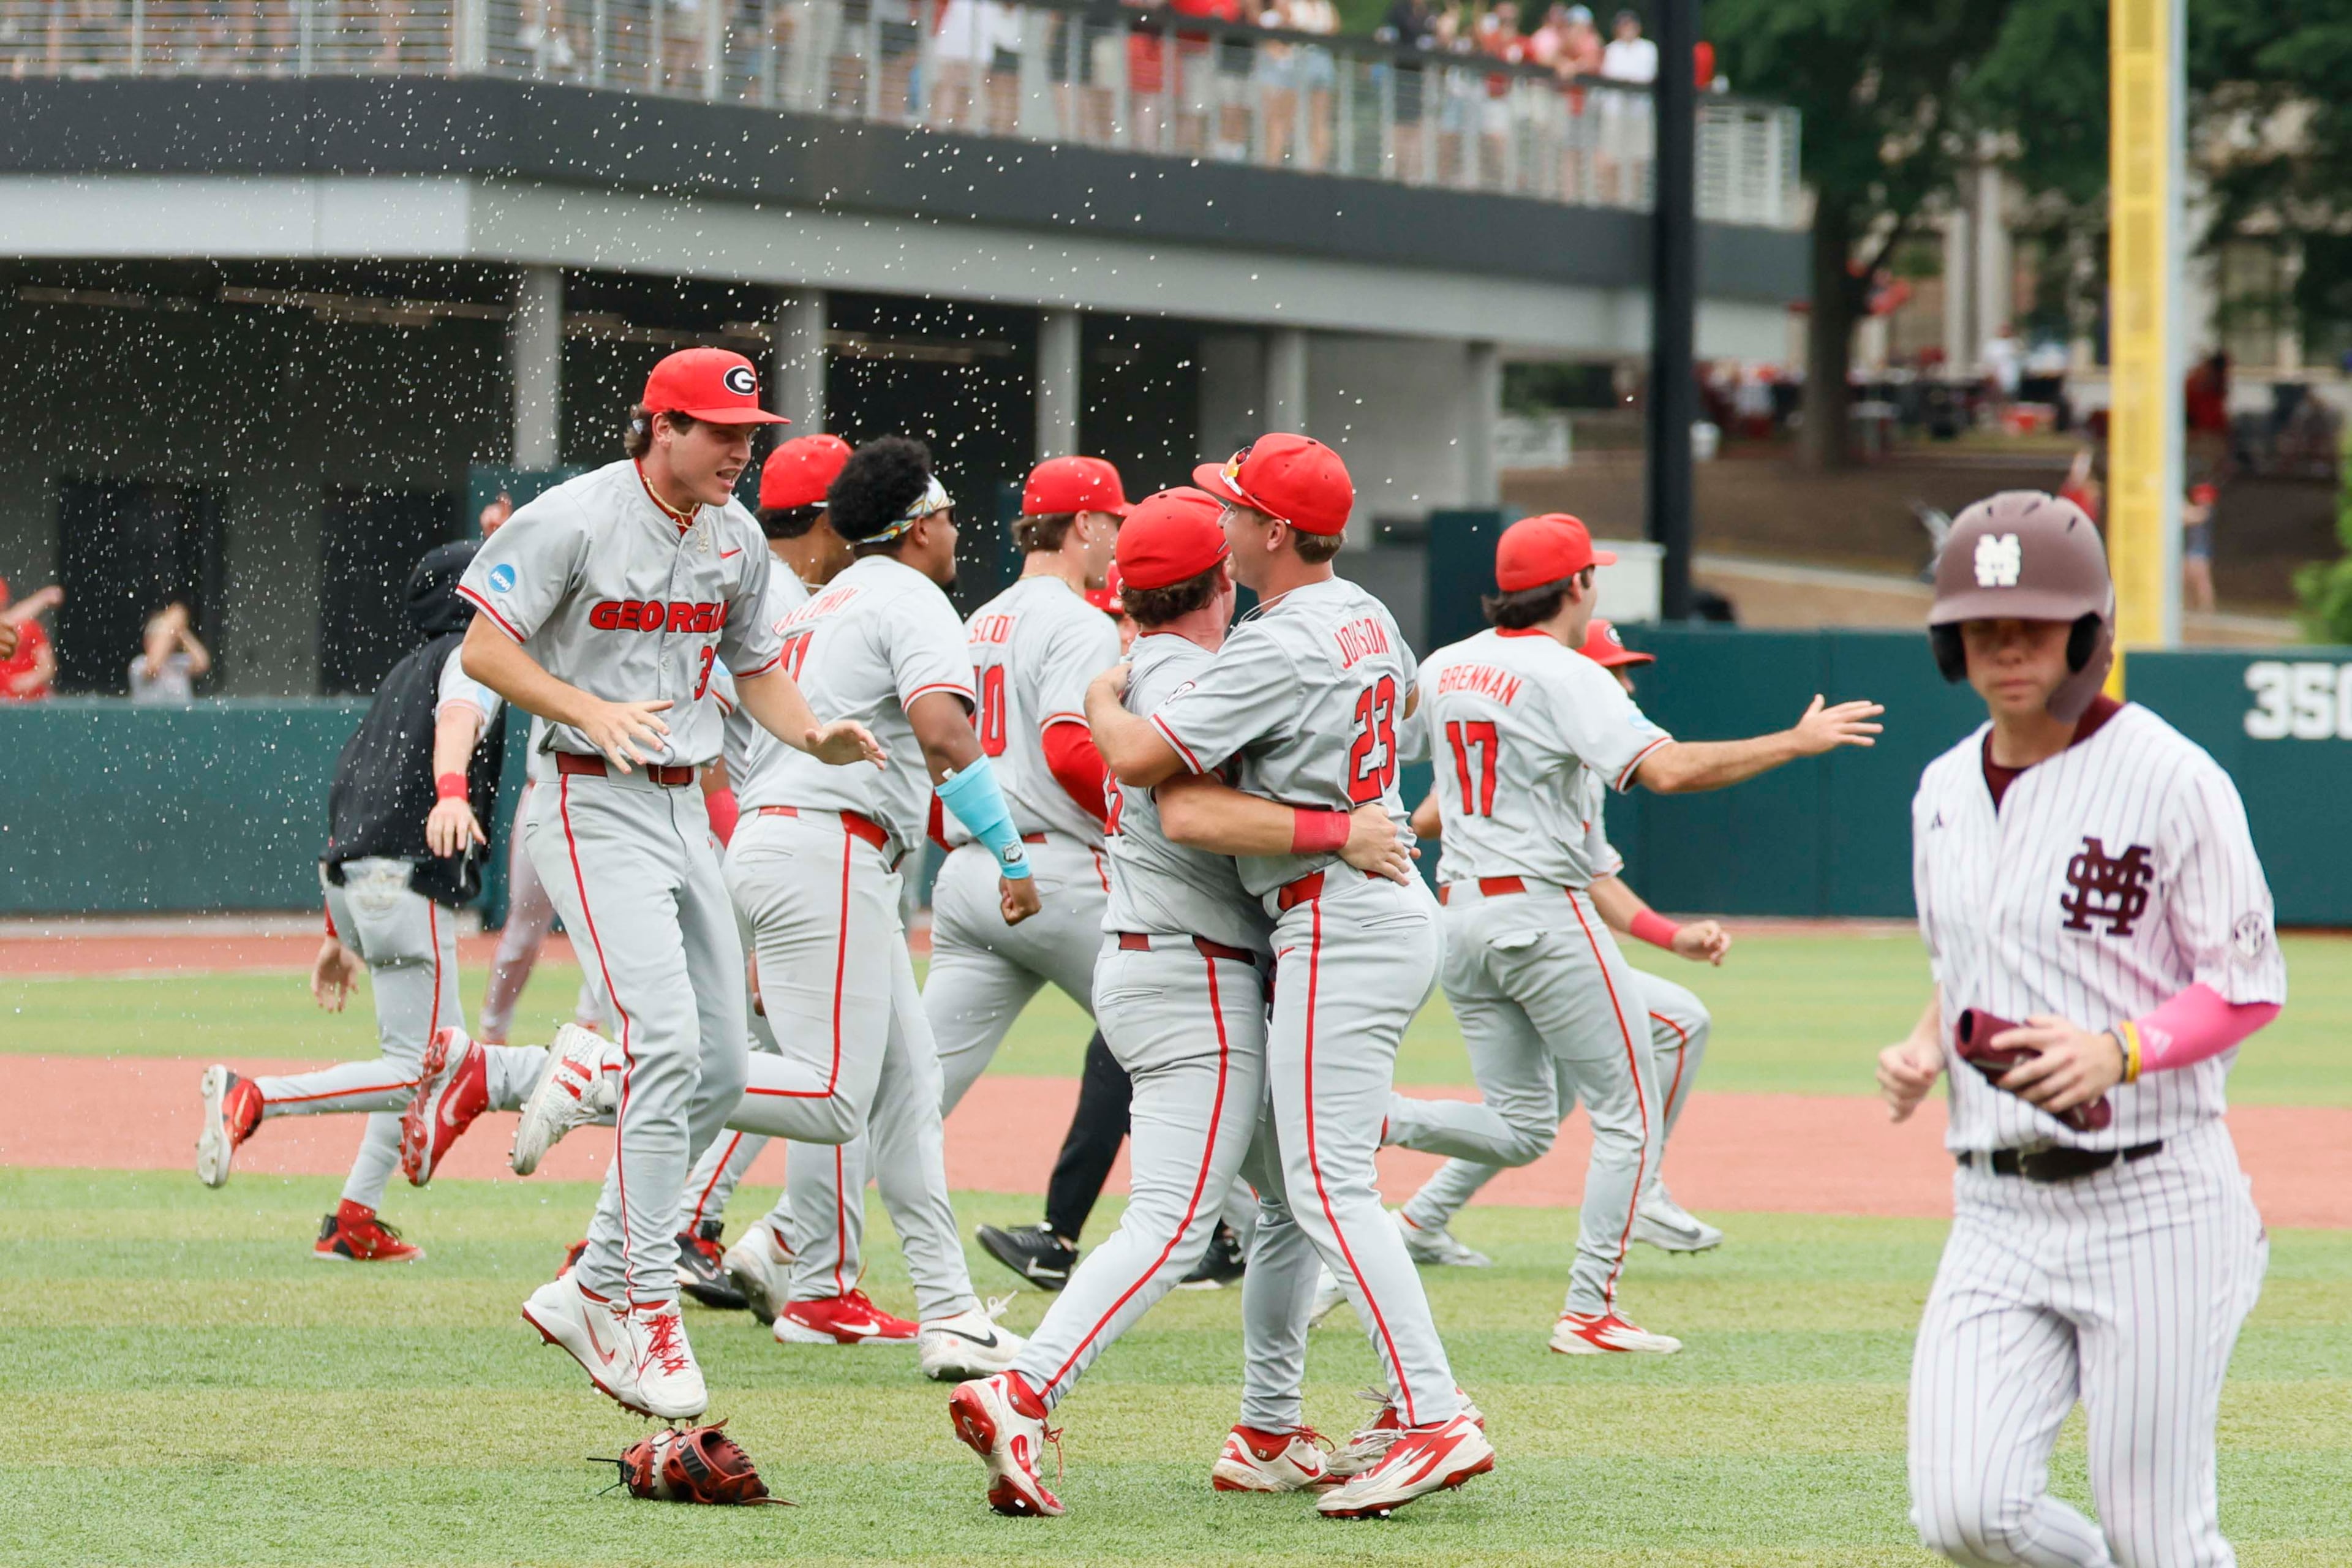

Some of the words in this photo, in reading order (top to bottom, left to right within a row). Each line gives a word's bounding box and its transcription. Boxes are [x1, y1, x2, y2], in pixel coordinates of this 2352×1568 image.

[1438, 663, 1524, 706] BRENNAN
[1348, 674, 1396, 805] 23
[1446, 720, 1498, 817] 17
